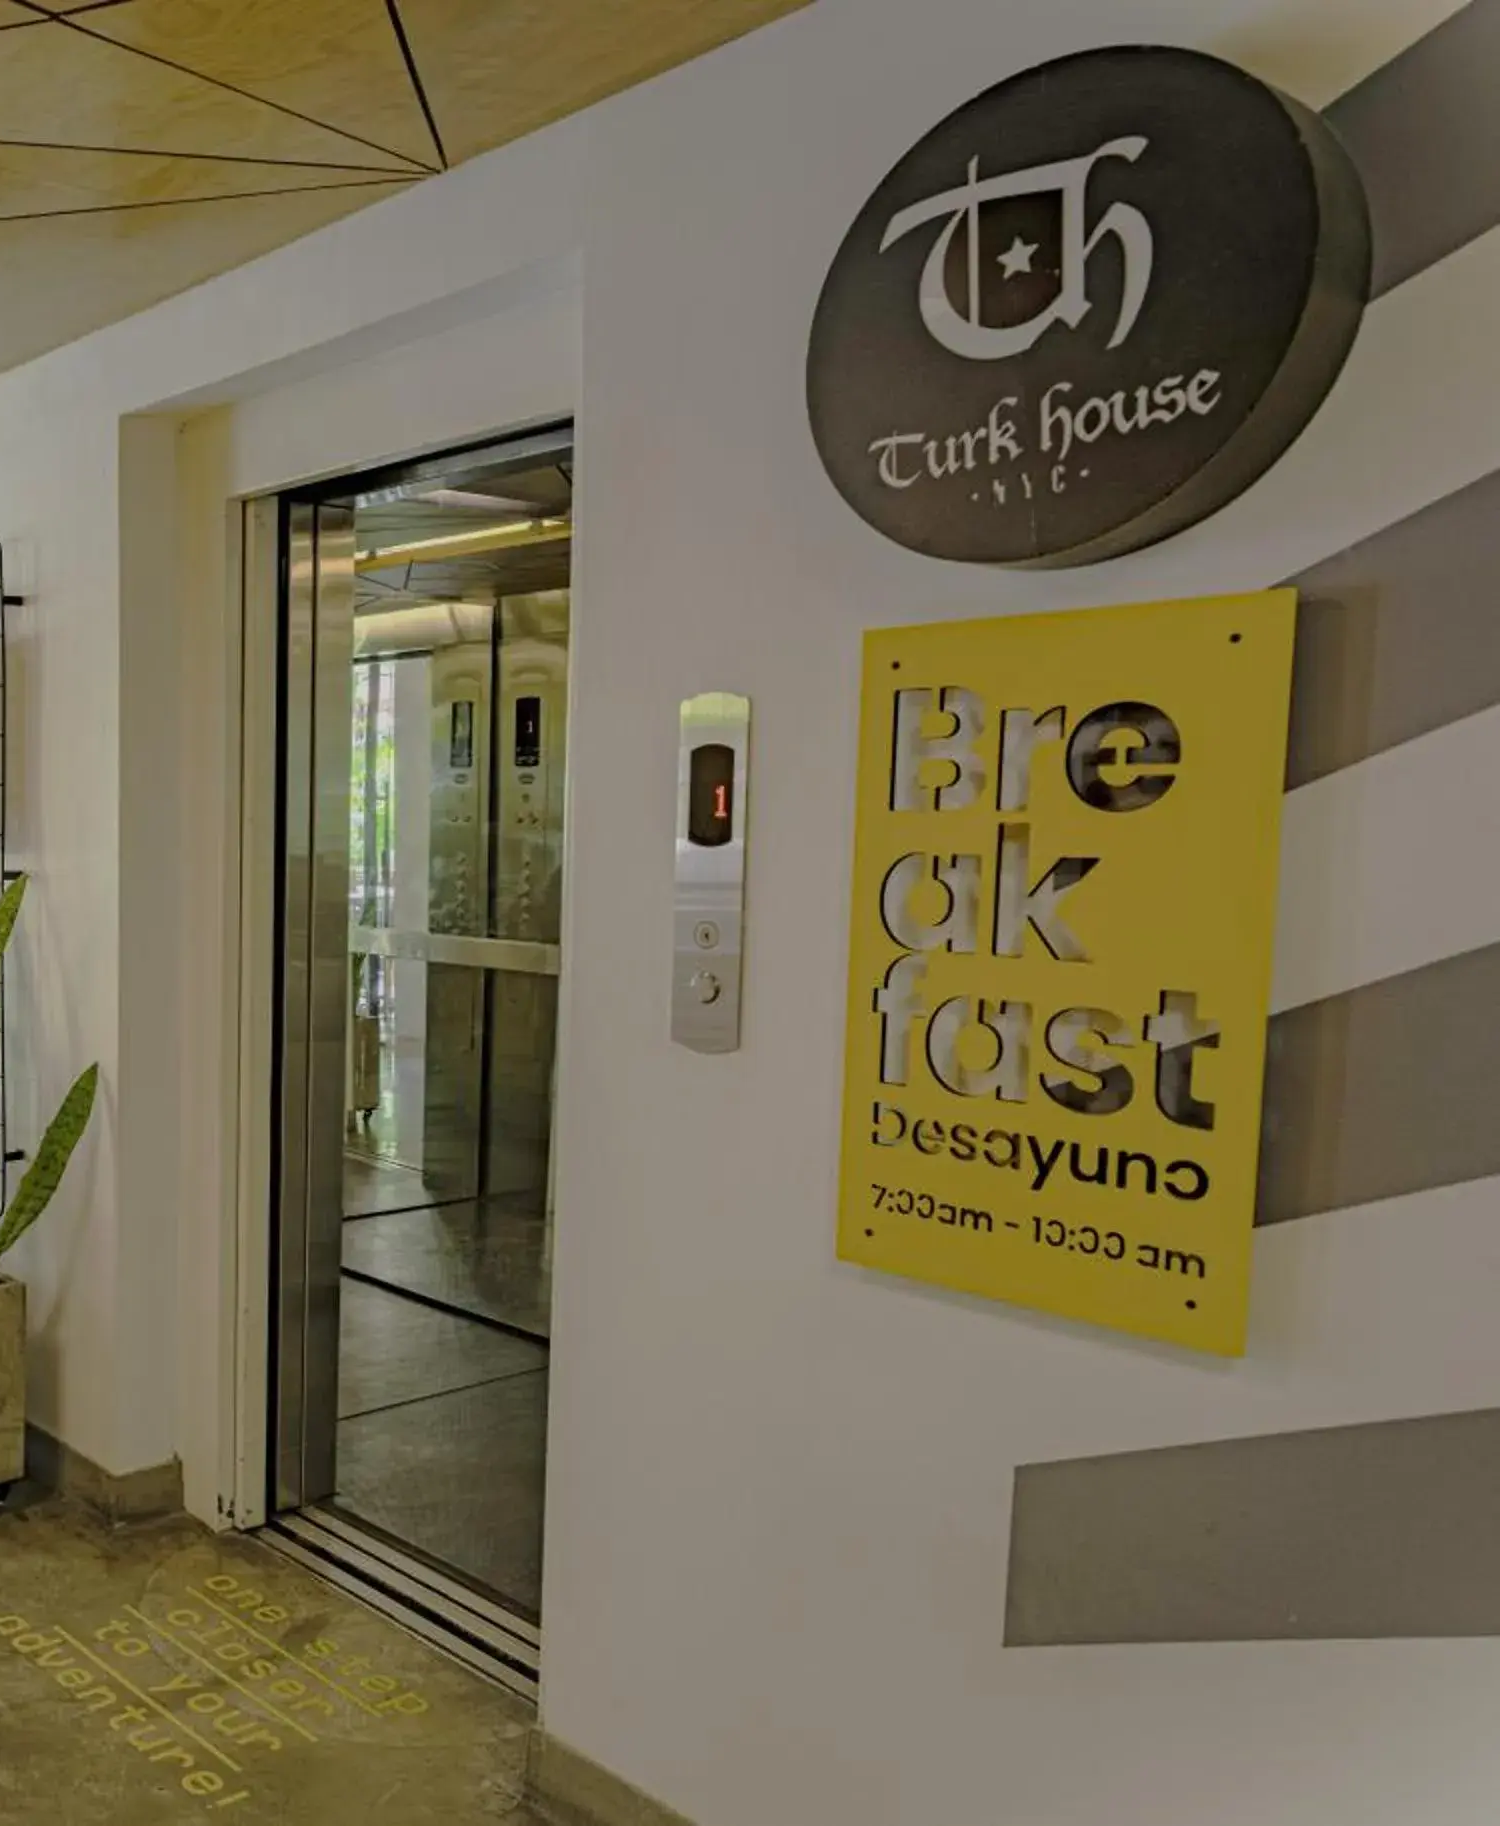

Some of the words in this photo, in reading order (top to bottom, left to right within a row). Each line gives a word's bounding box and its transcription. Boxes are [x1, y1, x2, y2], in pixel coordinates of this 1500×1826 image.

[867, 396, 1023, 489] Turk
[1039, 368, 1222, 460] house
[713, 785, 728, 818] 1
[889, 686, 1182, 813] Bre
[879, 822, 1102, 964] ak
[872, 950, 1222, 1133] fast
[871, 1101, 1210, 1202] Desayuno
[1135, 1244, 1206, 1279] am
[94, 1618, 150, 1658] to
[148, 1672, 283, 1751] your
[166, 1608, 334, 1716] closer
[204, 1574, 288, 1625] one
[304, 1637, 429, 1715] step
